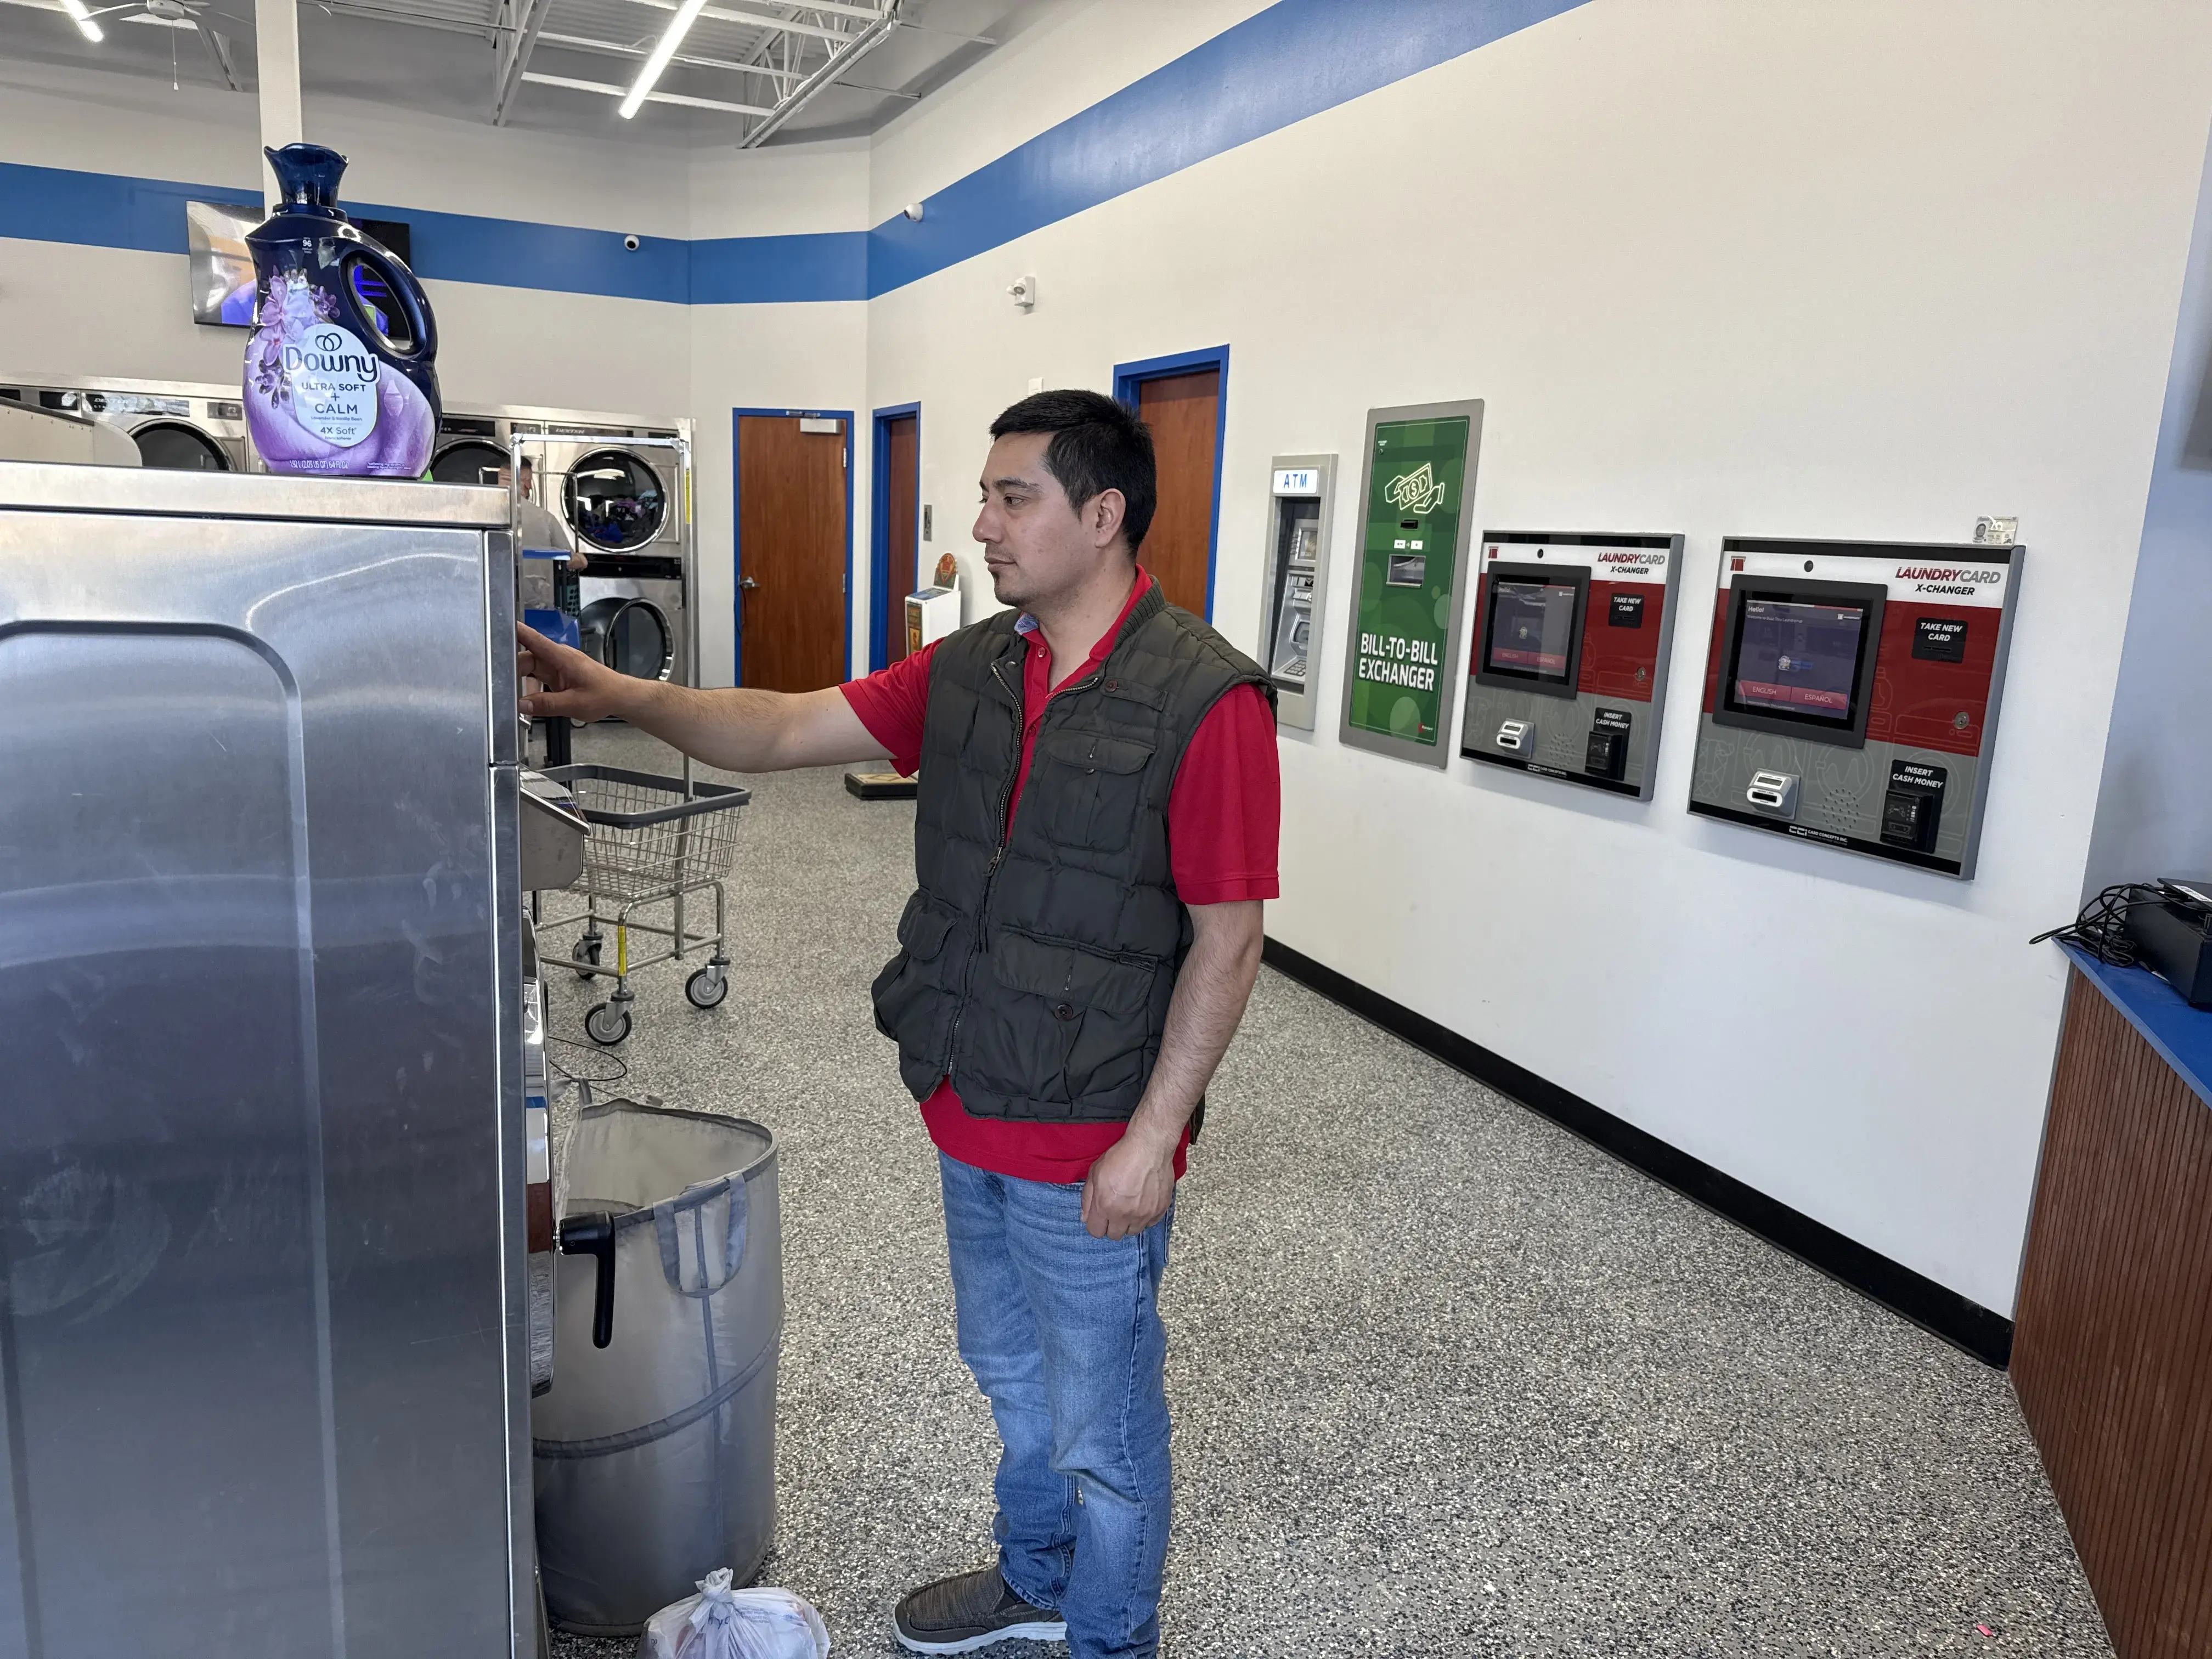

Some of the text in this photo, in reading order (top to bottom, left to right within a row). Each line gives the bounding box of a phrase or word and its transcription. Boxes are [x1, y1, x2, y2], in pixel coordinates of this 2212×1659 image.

[285, 346, 377, 383] Downy
[301, 382, 366, 392] ULTRA SOFT
[314, 403, 358, 414] CALM
[1283, 473, 1307, 489] ATM
[1597, 552, 1666, 565] LAUNDRYCARD
[1610, 566, 1649, 575] X-CHANGER
[1895, 566, 2001, 584] LAUNDRYCARD
[1915, 584, 1976, 596] X-CHANGER
[1920, 622, 1963, 633] TAKE NEW
[1928, 633, 1951, 641] CARD
[1360, 633, 1438, 665] BILL-TO-BILL
[1358, 657, 1435, 691] EXCHANGER
[1752, 686, 1777, 695] ENGLISH
[1804, 693, 1833, 704] ESPAÑOL
[1603, 712, 1623, 720] INSERT
[1610, 720, 1630, 729] MONEY
[1904, 765, 1934, 777] INSERT
[1892, 773, 1944, 788] CASH MONEY
[1819, 832, 1839, 840] CONCEPTS
